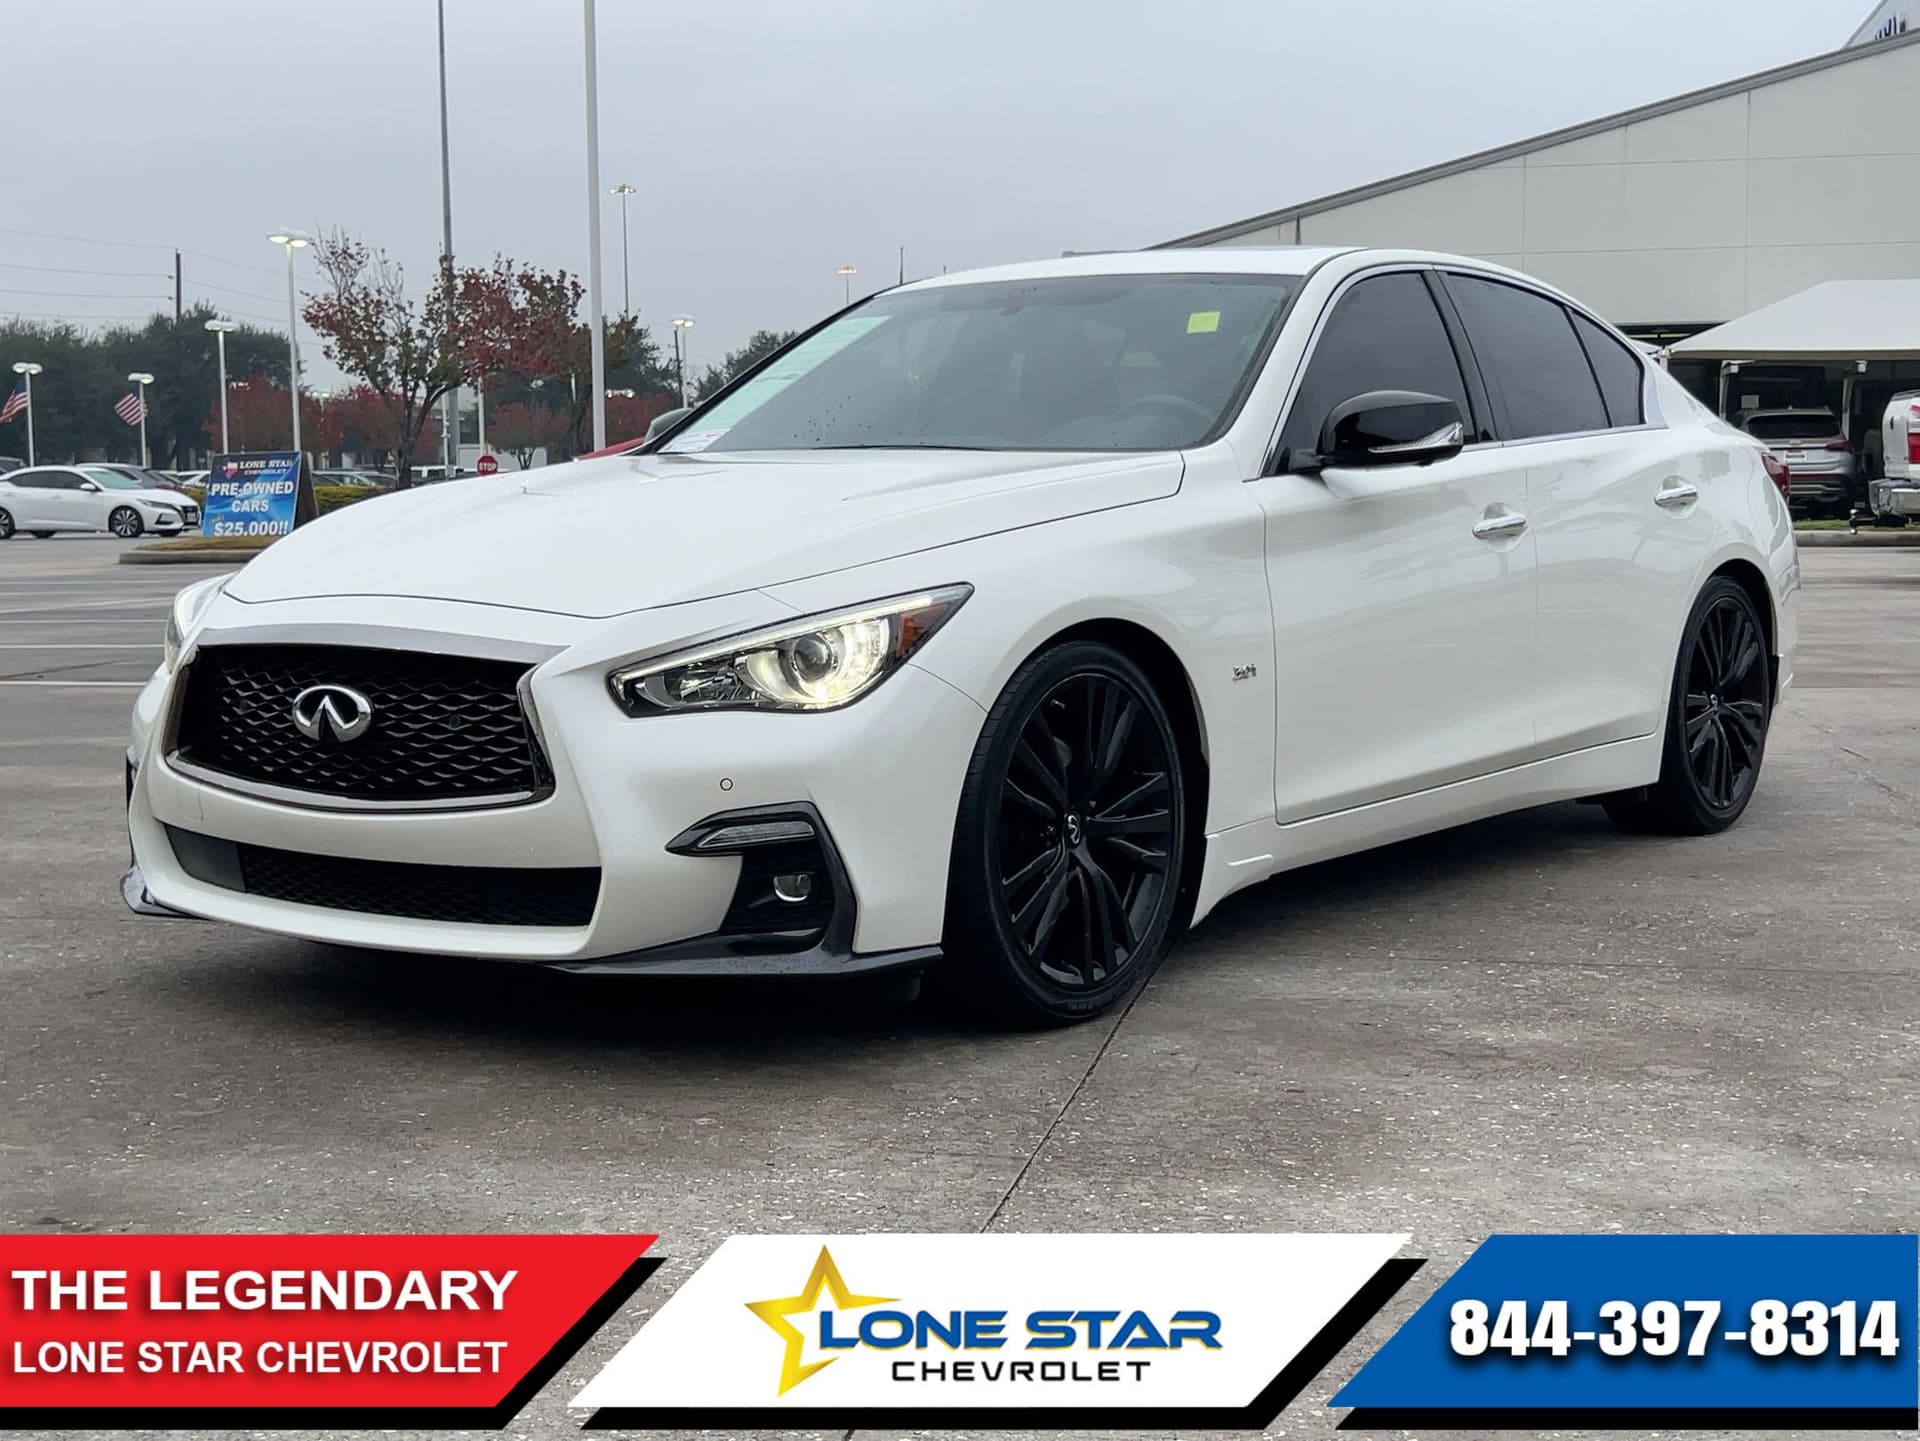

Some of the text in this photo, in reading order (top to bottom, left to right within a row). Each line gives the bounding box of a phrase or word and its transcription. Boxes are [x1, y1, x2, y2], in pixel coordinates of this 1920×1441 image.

[240, 461, 266, 469] LONE
[479, 463, 497, 471] STOP
[210, 481, 294, 497] PRE-OWNED
[231, 500, 269, 513] CARS
